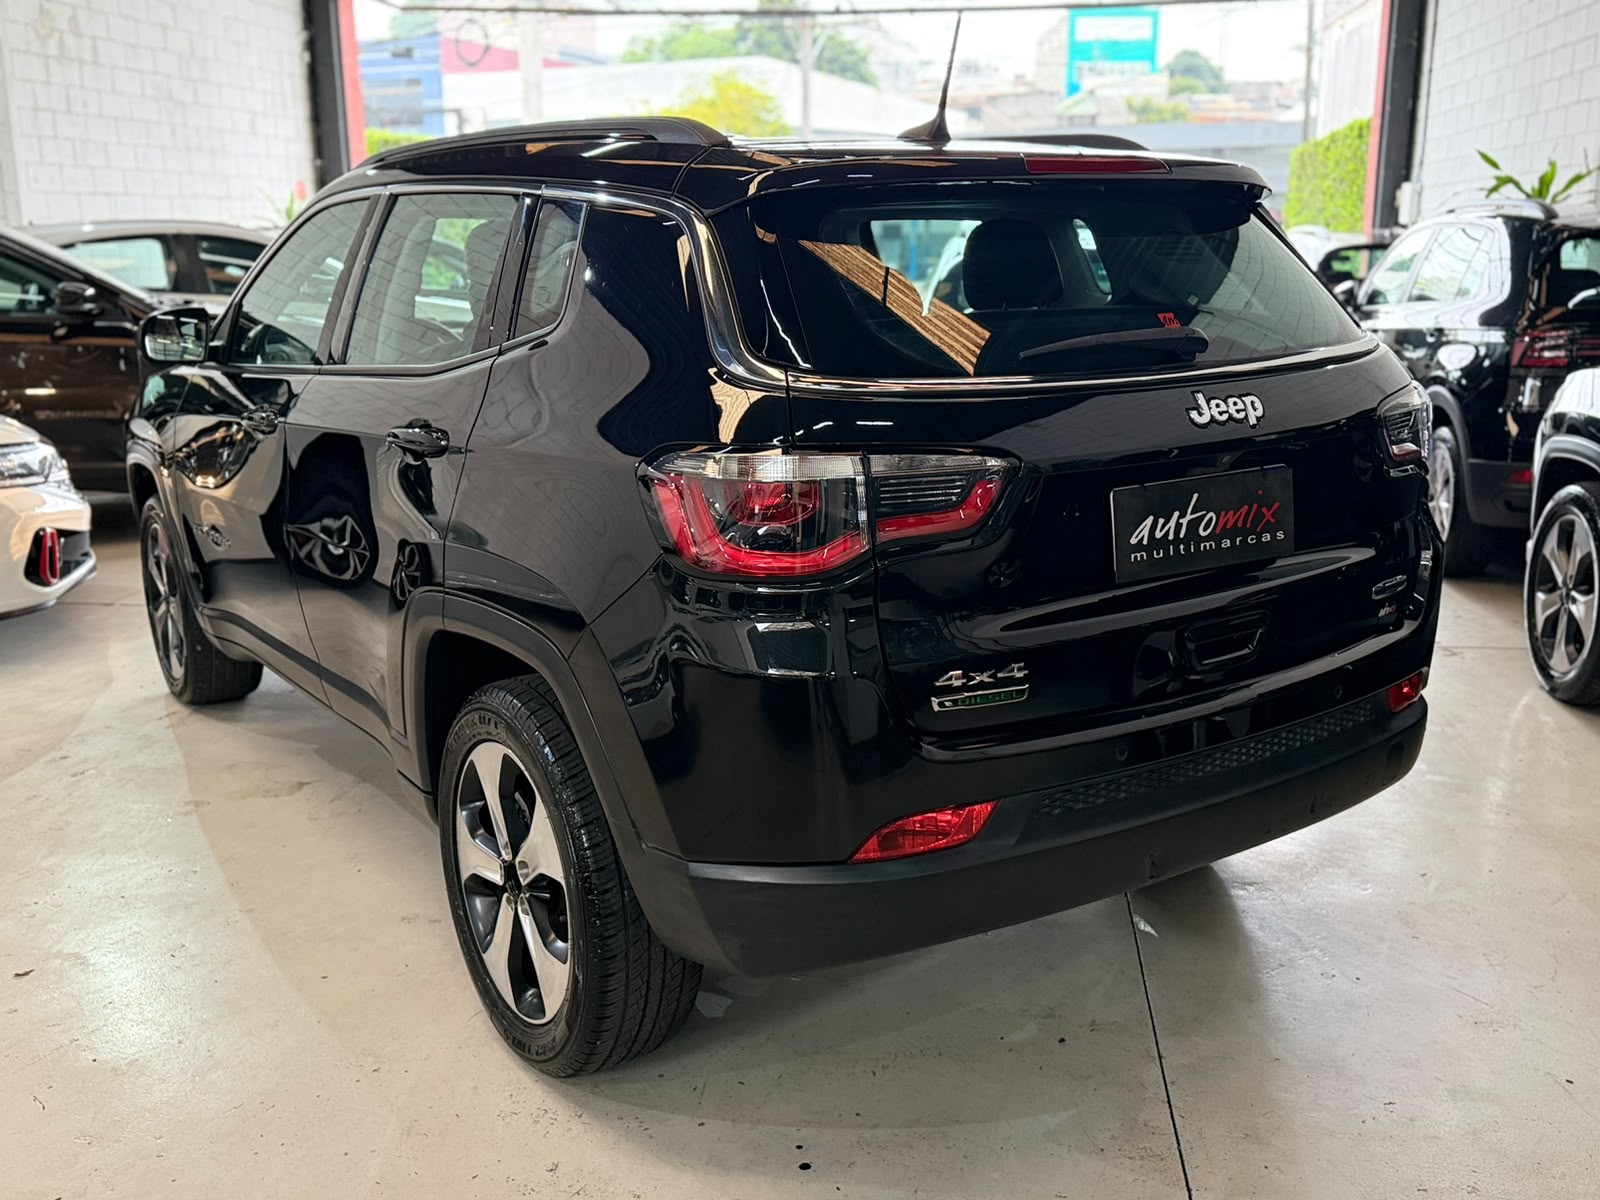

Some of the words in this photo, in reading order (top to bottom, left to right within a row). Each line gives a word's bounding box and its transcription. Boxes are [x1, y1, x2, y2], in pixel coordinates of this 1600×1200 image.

[1186, 391, 1265, 428] Jeep
[1129, 490, 1281, 545] automix
[1131, 530, 1286, 563] multimarcas
[958, 690, 1022, 706] DIESEL
